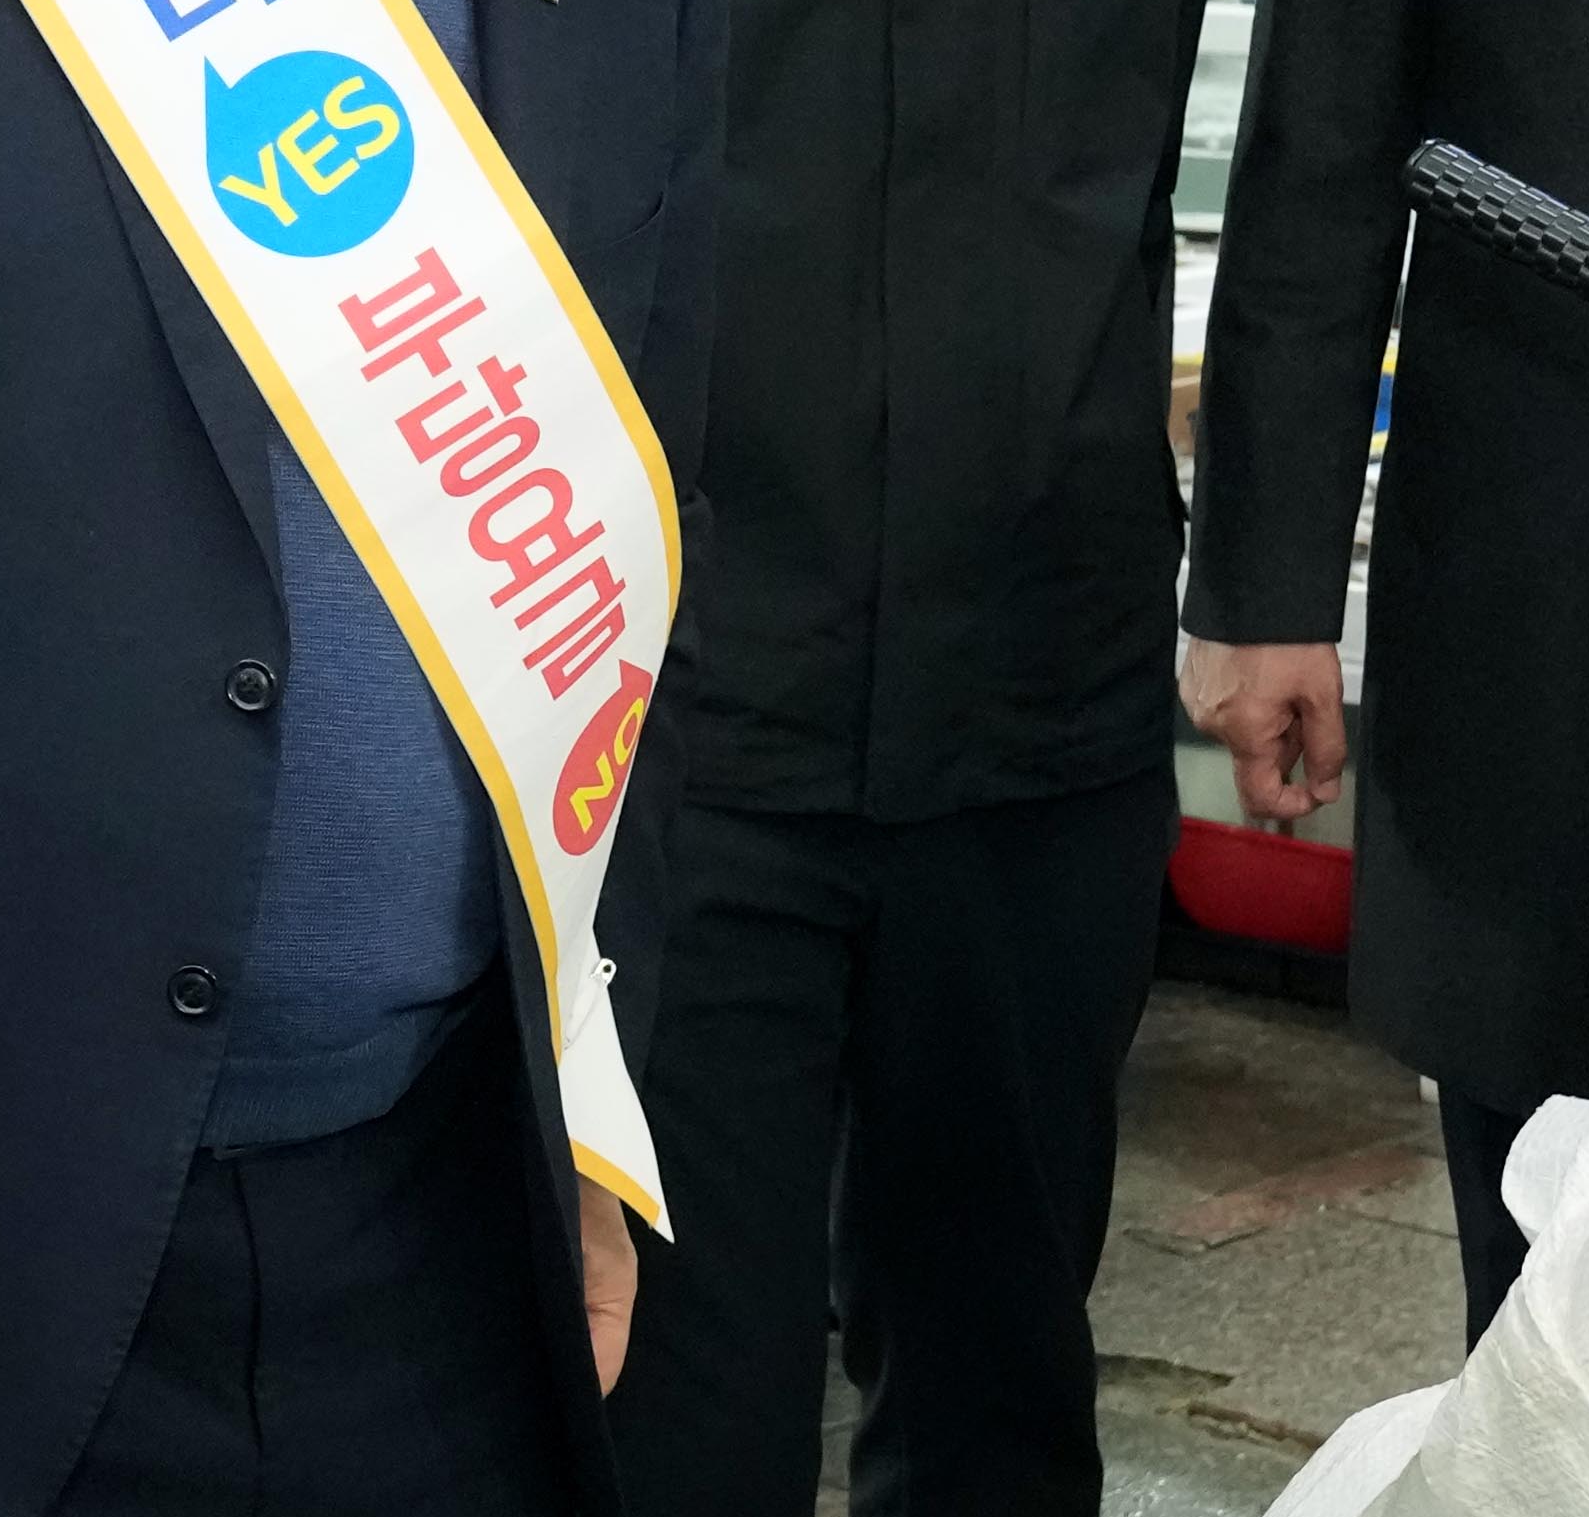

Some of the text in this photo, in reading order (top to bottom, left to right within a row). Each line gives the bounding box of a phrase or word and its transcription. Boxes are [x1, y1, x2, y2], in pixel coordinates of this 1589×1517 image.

[219, 75, 402, 228] YES
[336, 246, 627, 702] 부당요금
[568, 696, 646, 834] NO
